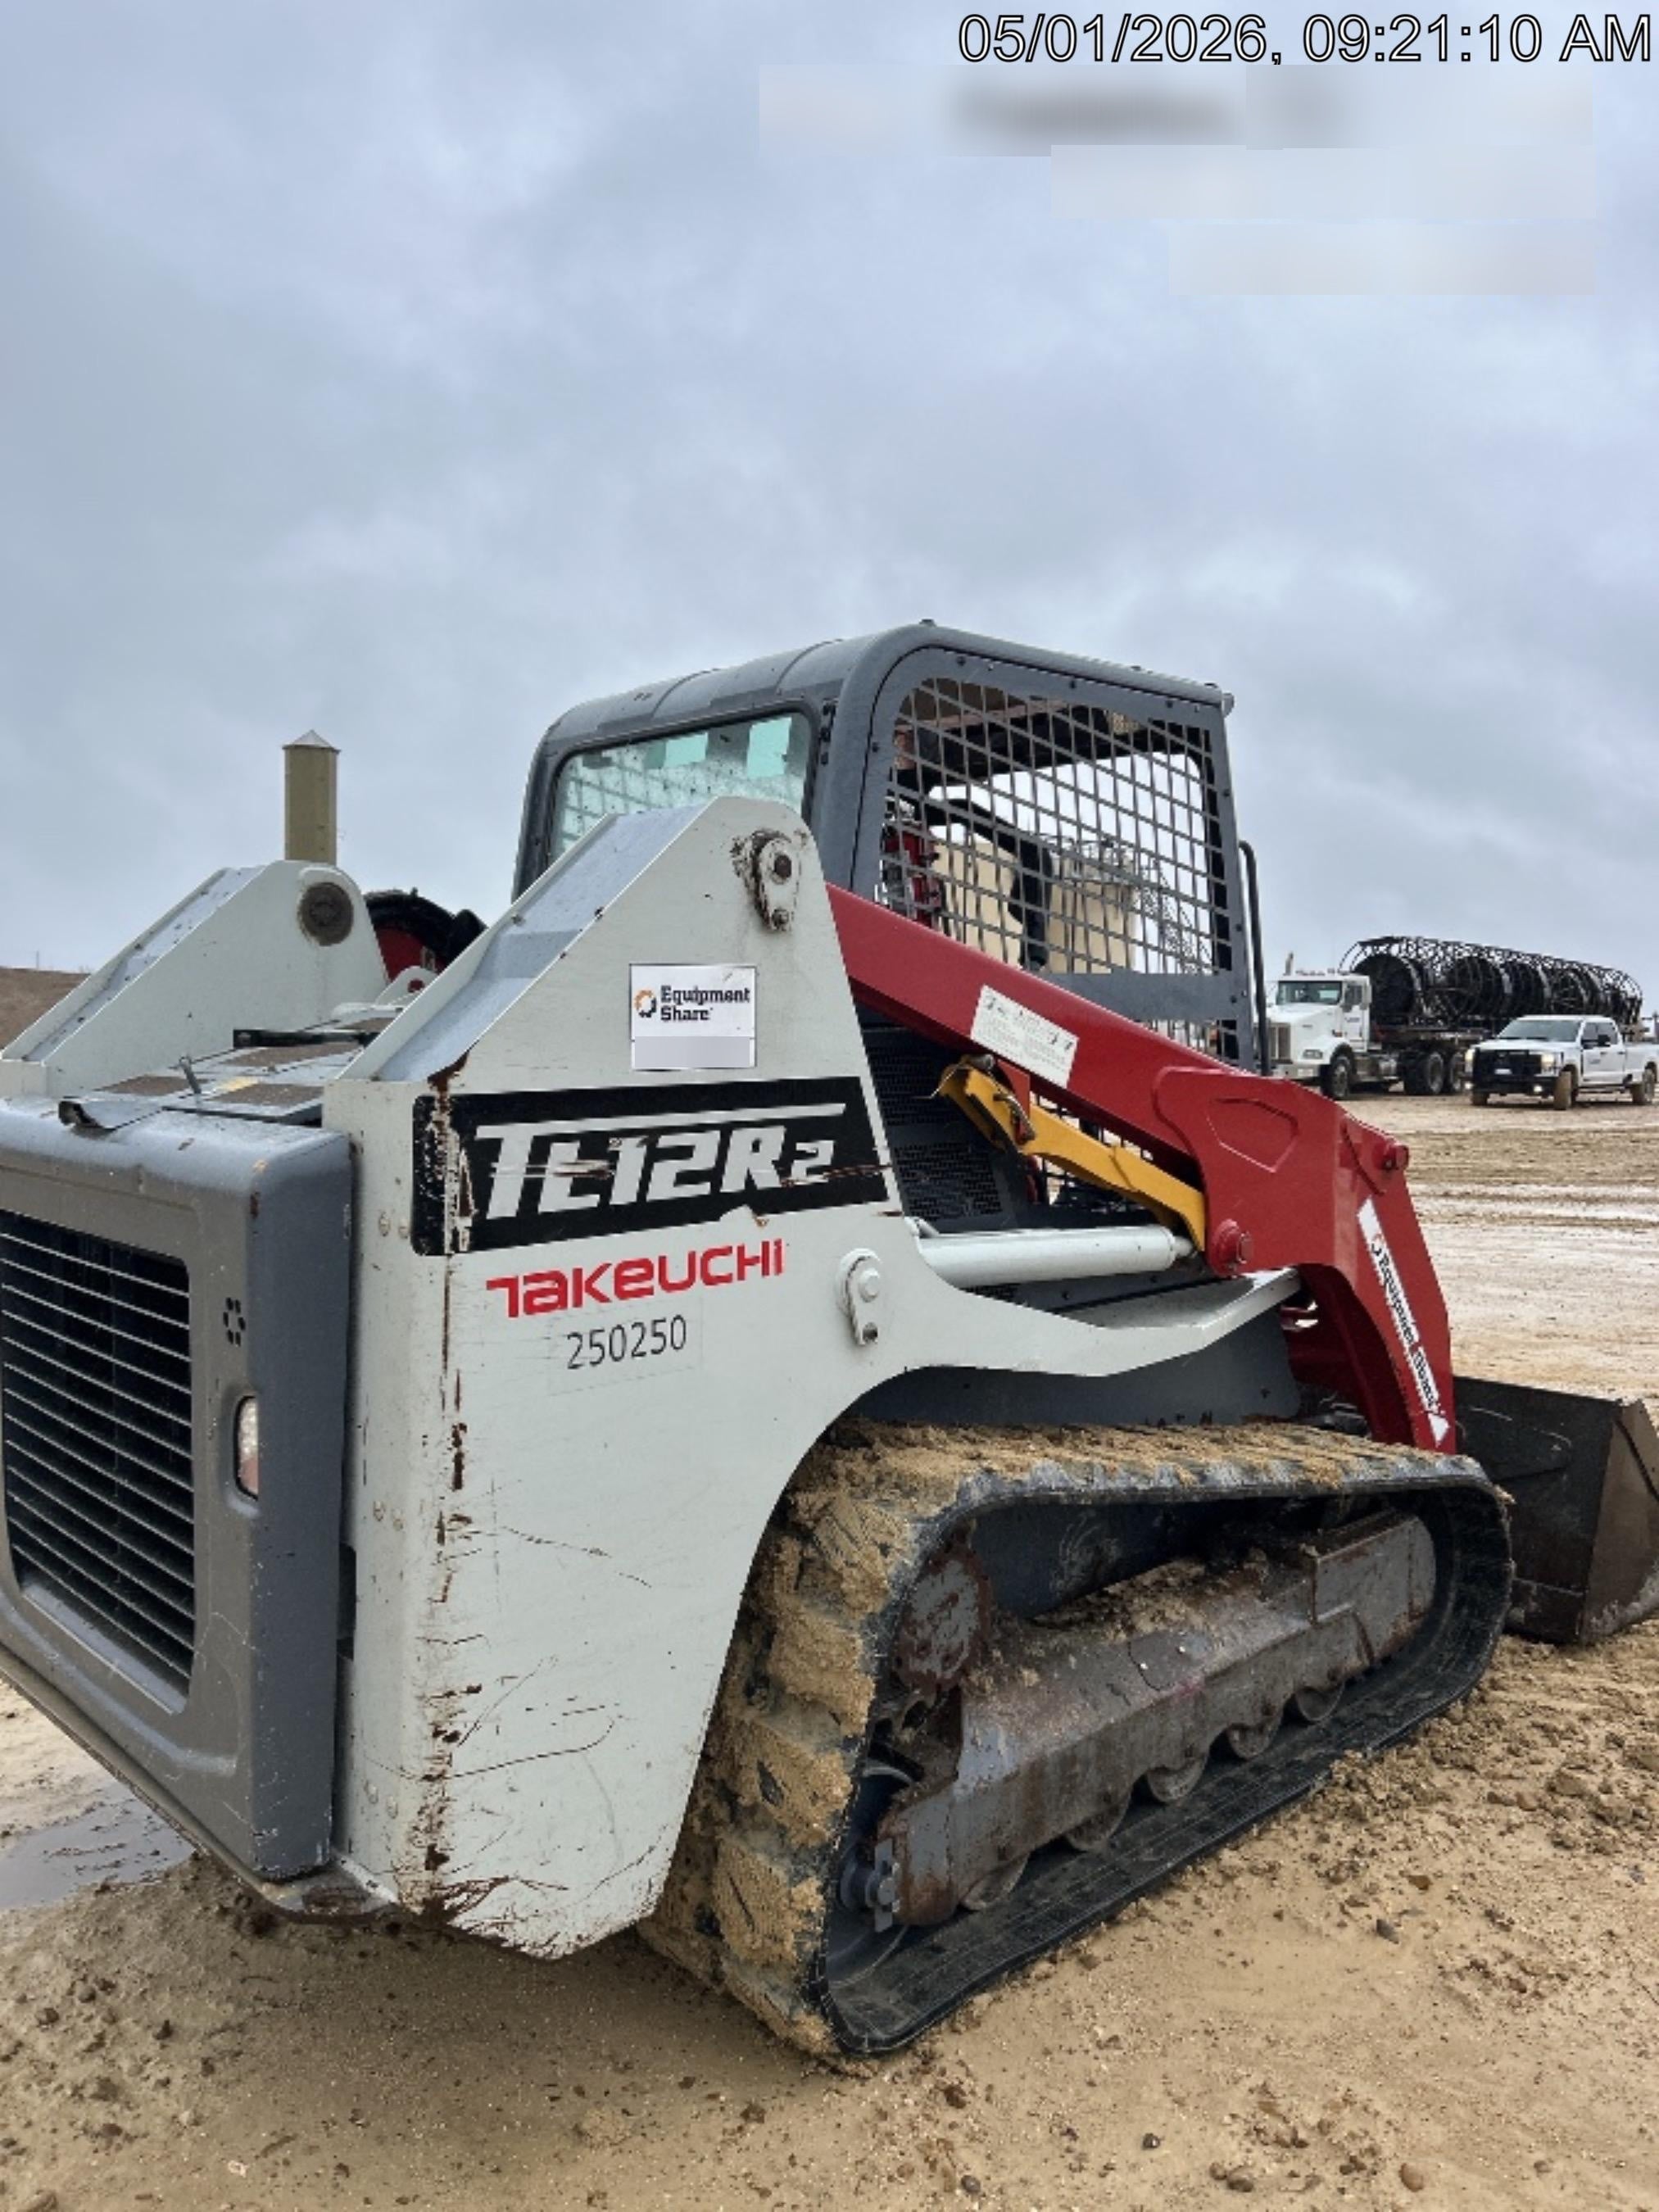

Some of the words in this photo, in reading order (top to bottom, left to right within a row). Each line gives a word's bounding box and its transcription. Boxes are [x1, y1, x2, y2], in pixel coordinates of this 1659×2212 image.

[660, 986, 750, 1005] Equipment
[660, 1005, 709, 1021] Share
[486, 1238, 784, 1318] TAKEUCHI
[567, 1314, 687, 1369] 250250
